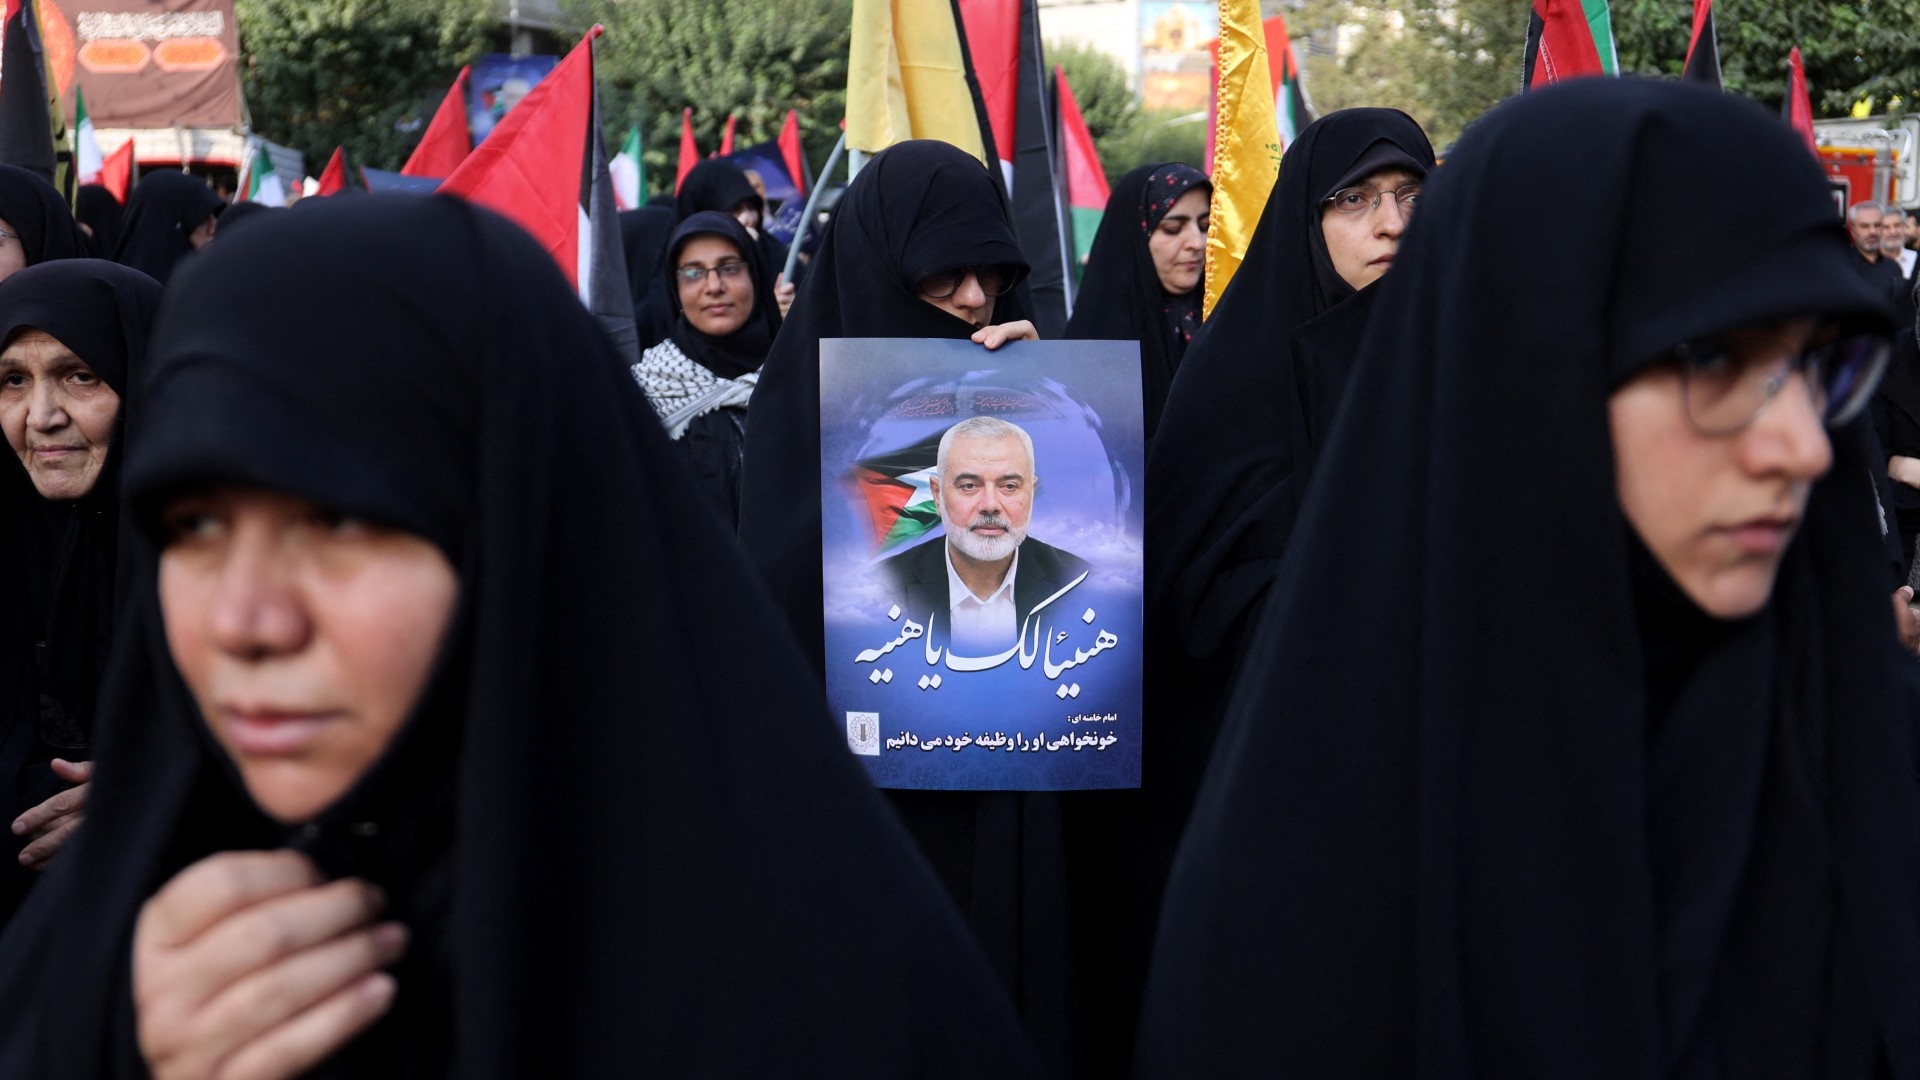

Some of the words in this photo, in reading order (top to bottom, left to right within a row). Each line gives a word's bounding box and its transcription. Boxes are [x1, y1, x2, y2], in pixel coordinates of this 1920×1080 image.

[917, 612, 942, 689] یا
[1082, 713, 1102, 722] خامنه
[1102, 713, 1117, 723] امام
[944, 731, 973, 751] خود
[975, 731, 1015, 751] وظیفه
[1016, 731, 1030, 751] را
[1031, 731, 1045, 751] او
[1046, 731, 1118, 751] خونخواهی
